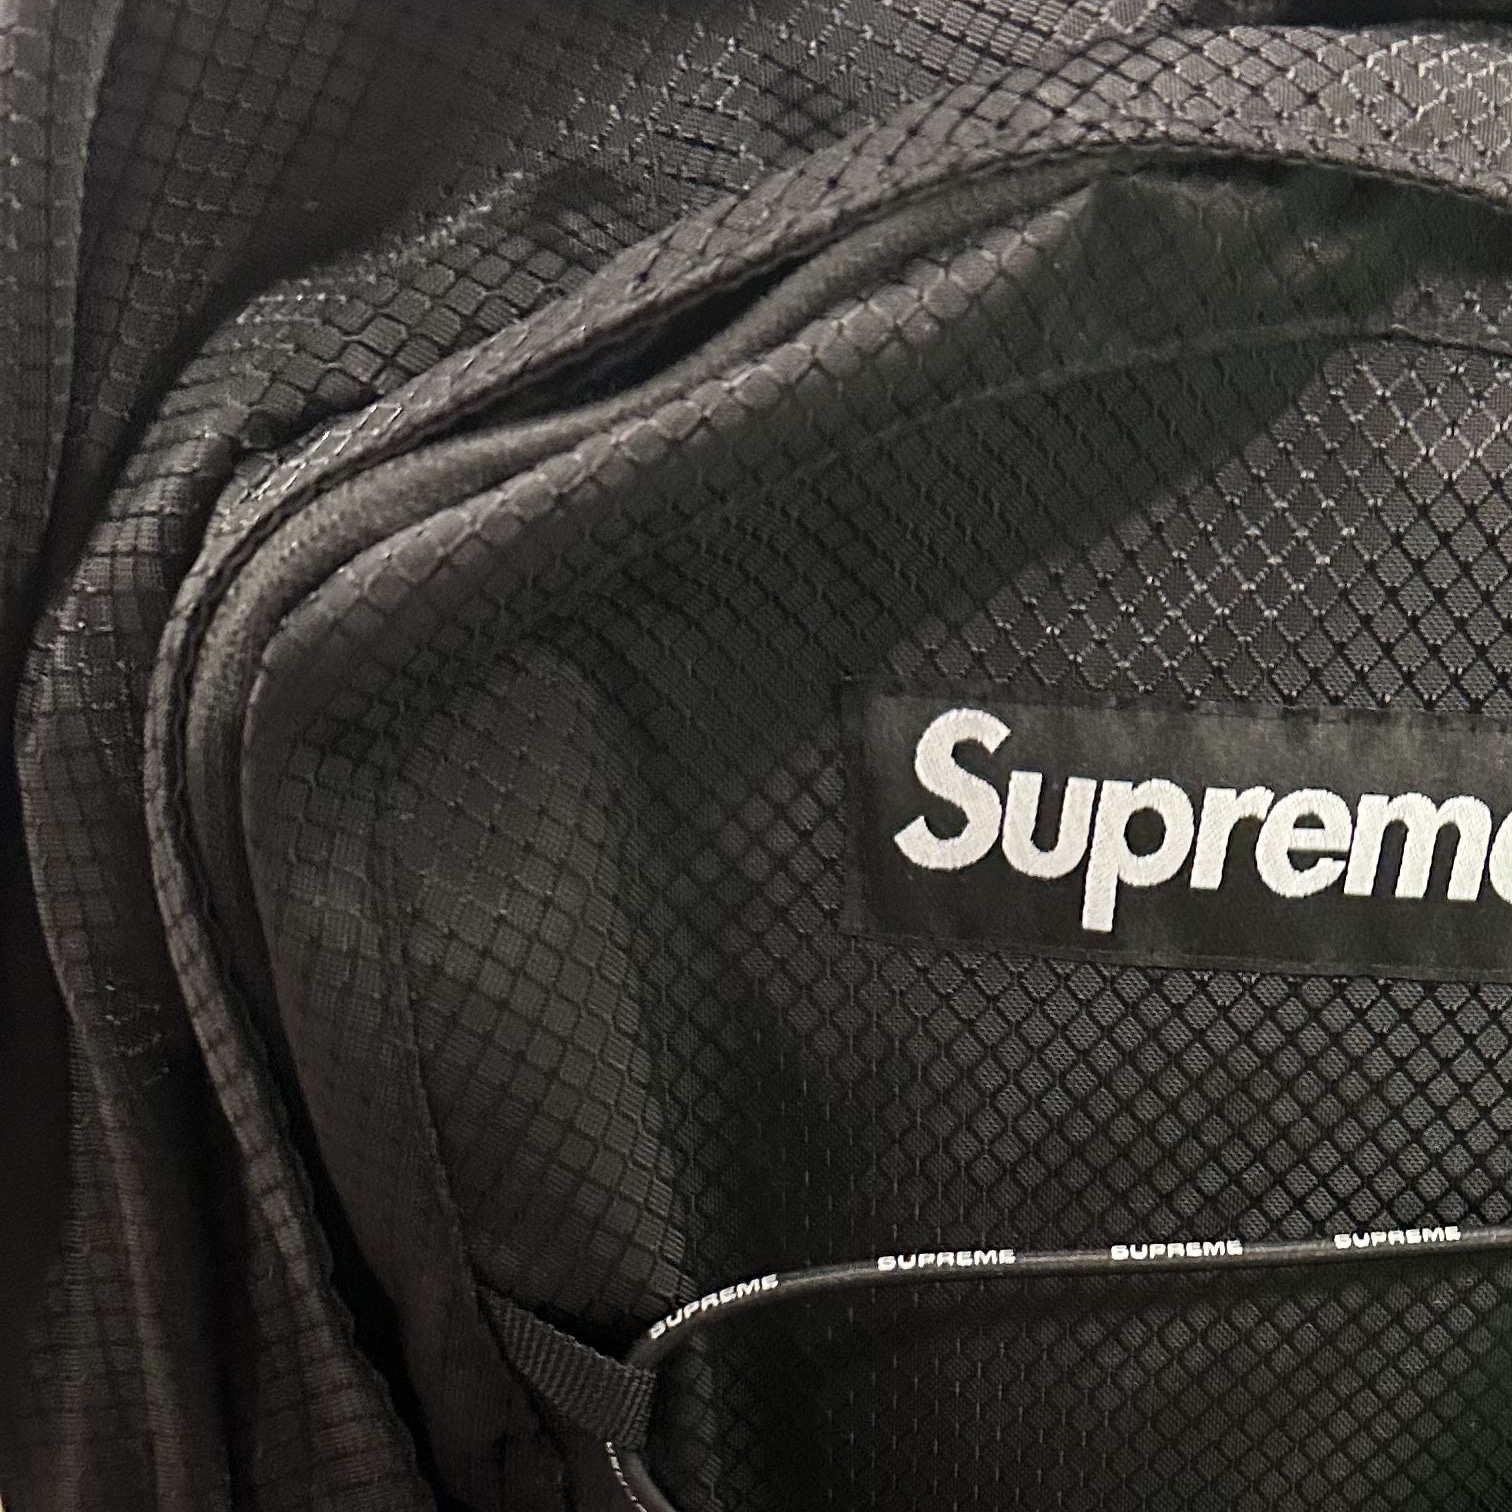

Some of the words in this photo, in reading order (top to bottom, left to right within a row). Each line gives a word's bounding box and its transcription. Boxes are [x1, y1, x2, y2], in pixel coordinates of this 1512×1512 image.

[648, 1272, 780, 1340] SUPREME
[877, 1248, 1017, 1271] SUPREME
[1110, 1239, 1244, 1261] SUPREME
[1333, 1224, 1462, 1250] SUPREME
